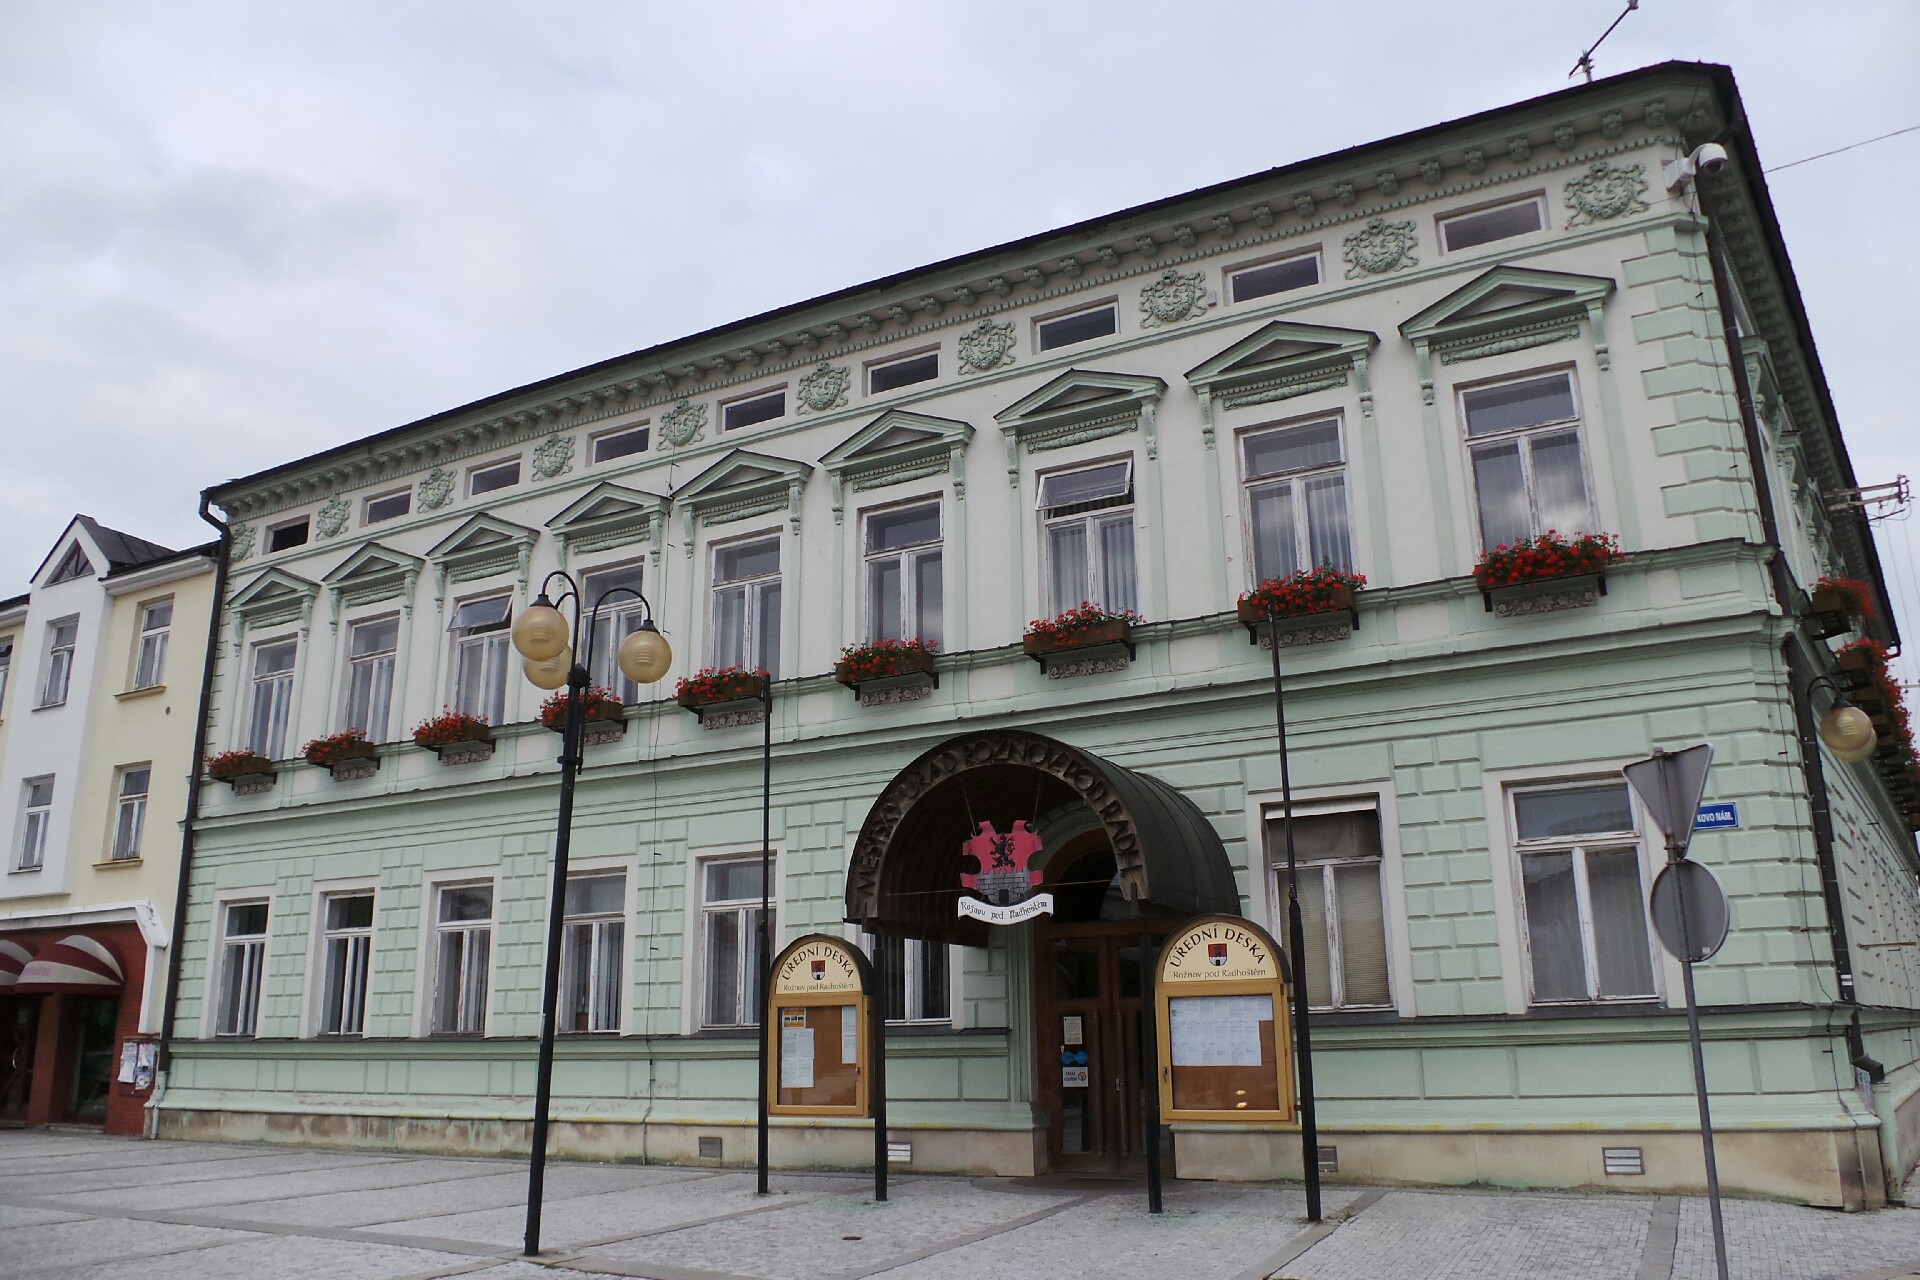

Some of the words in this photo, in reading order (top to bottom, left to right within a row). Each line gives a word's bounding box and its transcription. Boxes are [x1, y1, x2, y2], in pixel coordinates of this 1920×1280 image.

[1169, 923, 1218, 968] ÚŘEDNÍ
[1224, 928, 1266, 965] DESKA
[824, 946, 854, 978] DESKA
[1173, 970, 1202, 979] Rožnov
[1204, 970, 1220, 980] pod
[806, 983, 819, 992] pod
